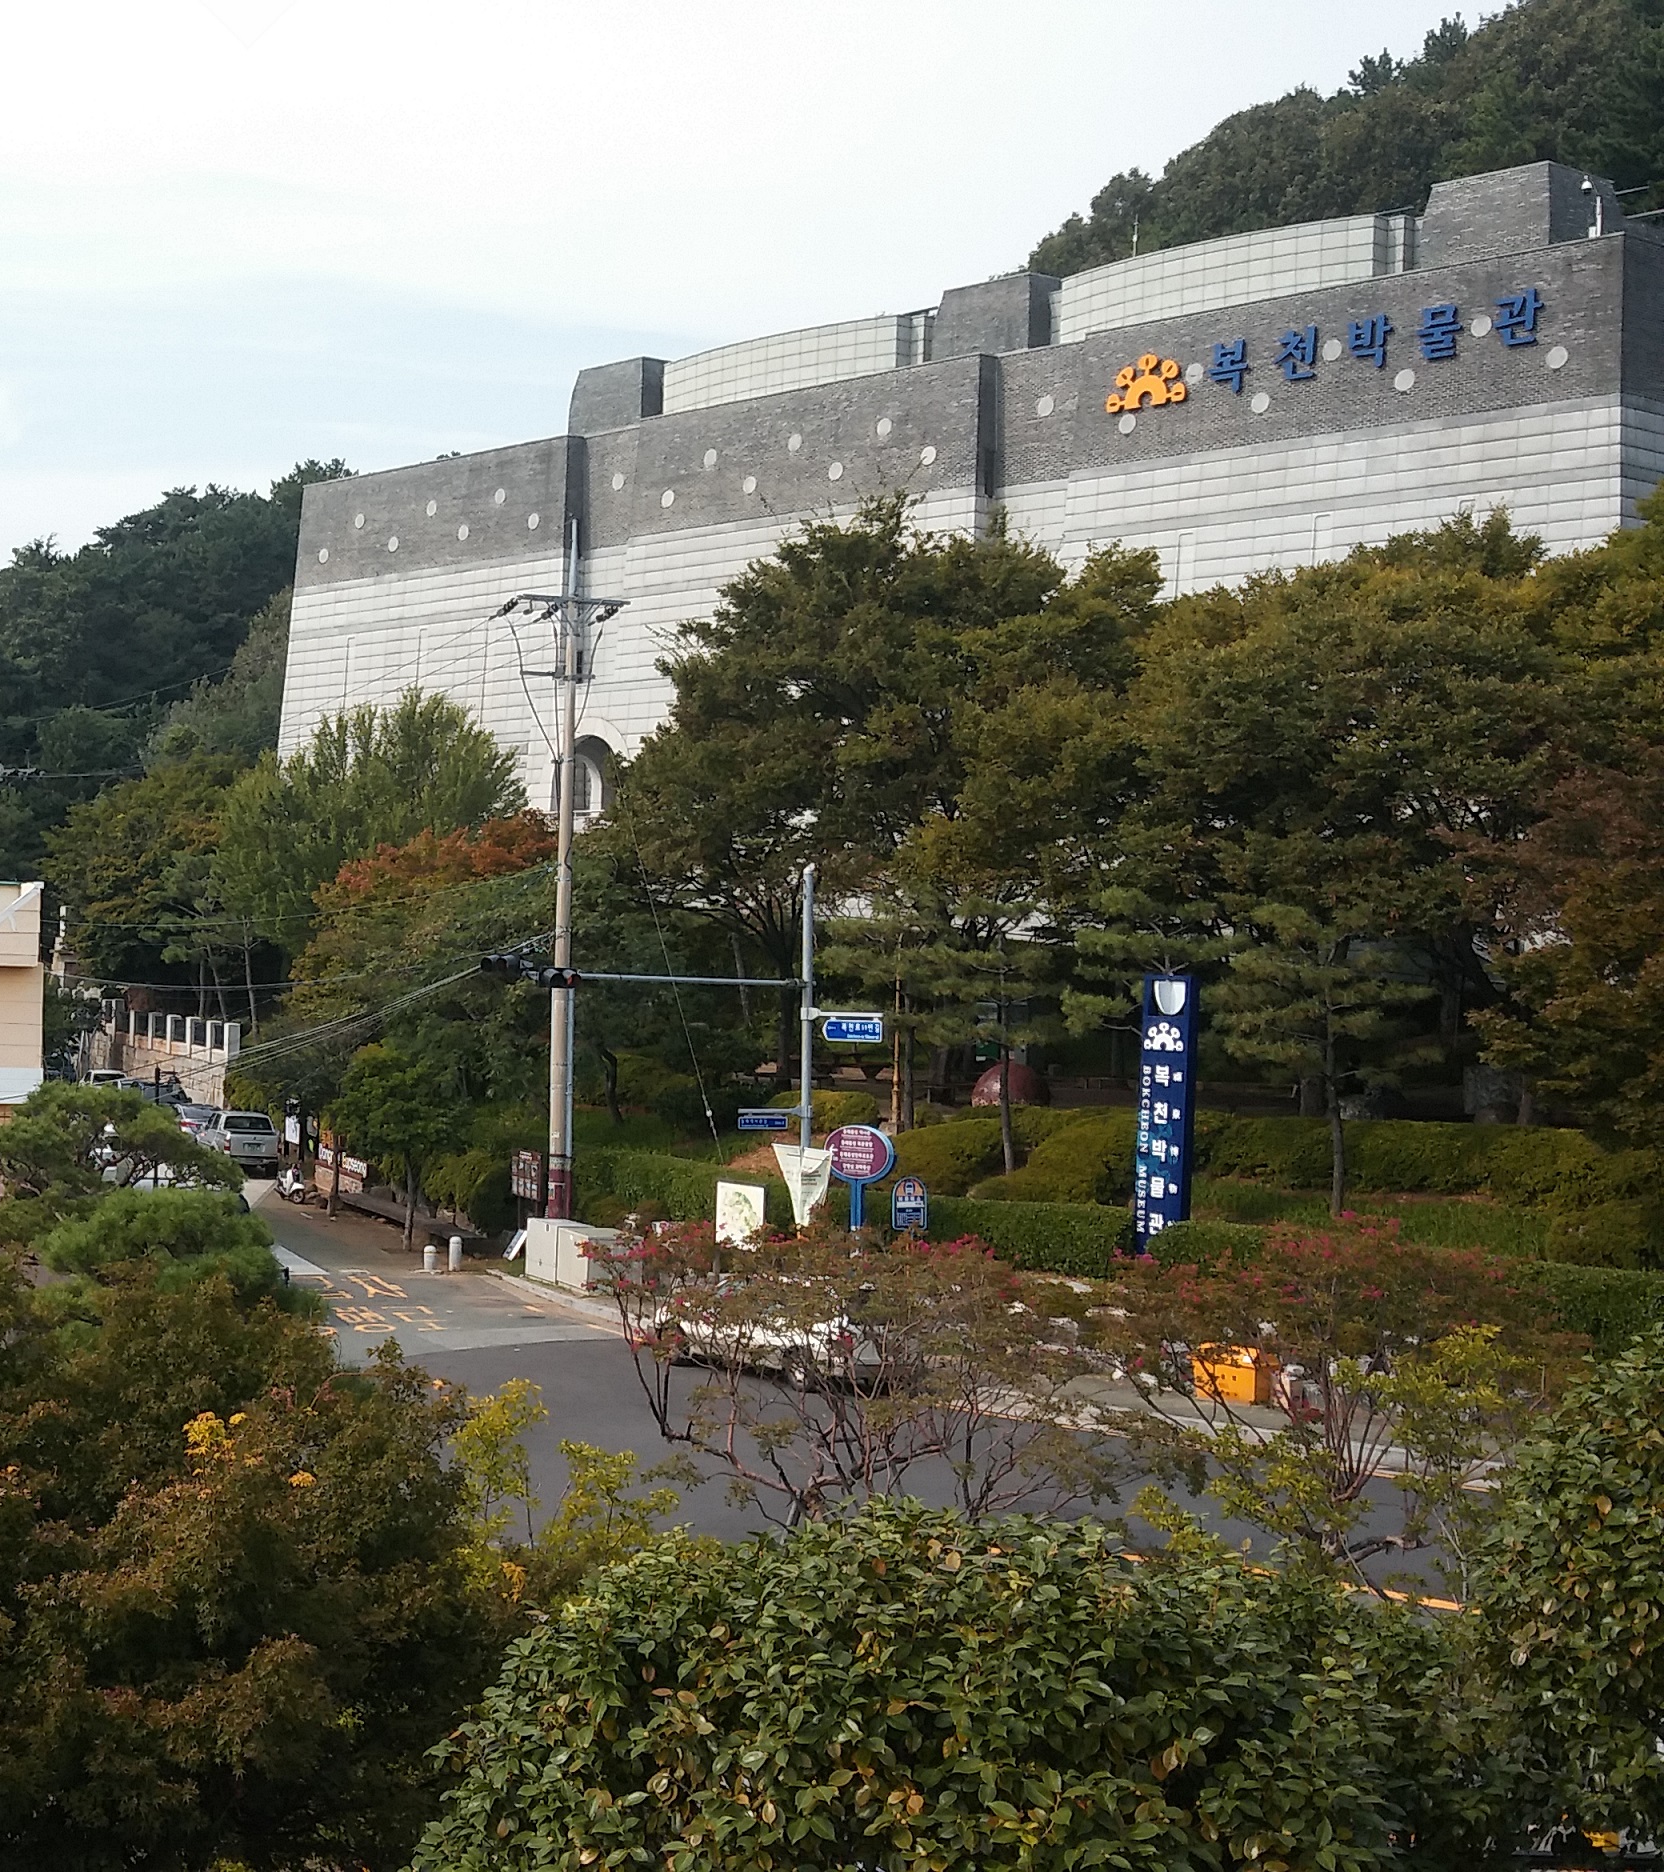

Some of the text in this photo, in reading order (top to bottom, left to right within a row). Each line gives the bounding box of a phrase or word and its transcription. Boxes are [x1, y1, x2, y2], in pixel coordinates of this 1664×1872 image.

[1208, 287, 1545, 394] 복천박물관
[1136, 1065, 1152, 1233] BOKCHEON MUSEUM
[1148, 1064, 1171, 1235] 복천박물관
